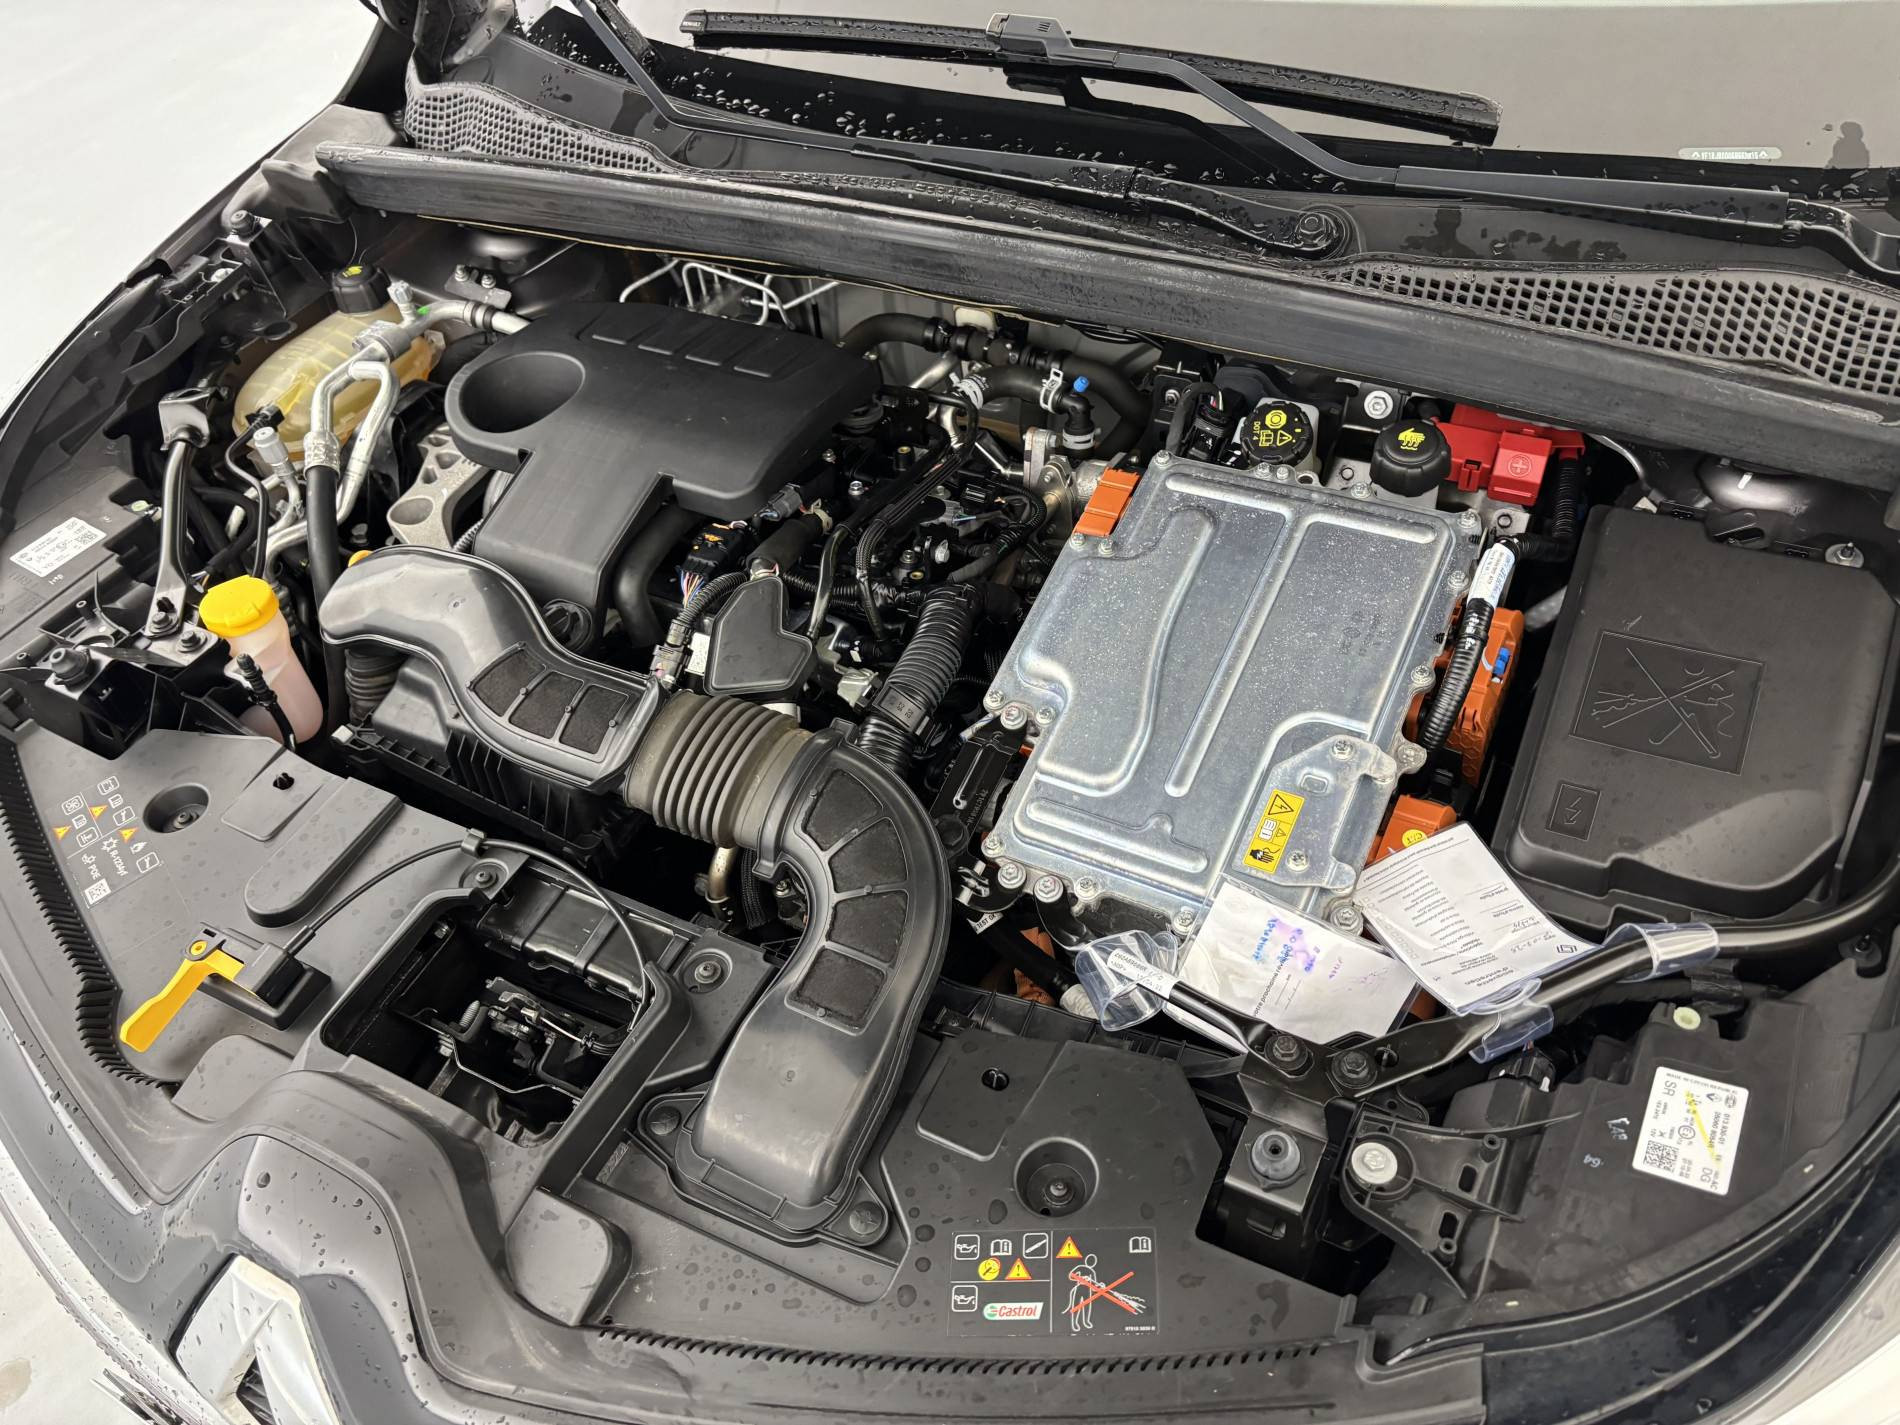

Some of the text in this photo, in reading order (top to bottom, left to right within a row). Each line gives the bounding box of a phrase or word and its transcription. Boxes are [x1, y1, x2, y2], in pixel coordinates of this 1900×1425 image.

[1253, 421, 1261, 434] DOT
[977, 919, 988, 928] TEST
[1258, 971, 1280, 1002] prochaine
[1661, 1079, 1677, 1097] SR
[1699, 1166, 1713, 1183] DG
[998, 1304, 1038, 1318] Castrol
